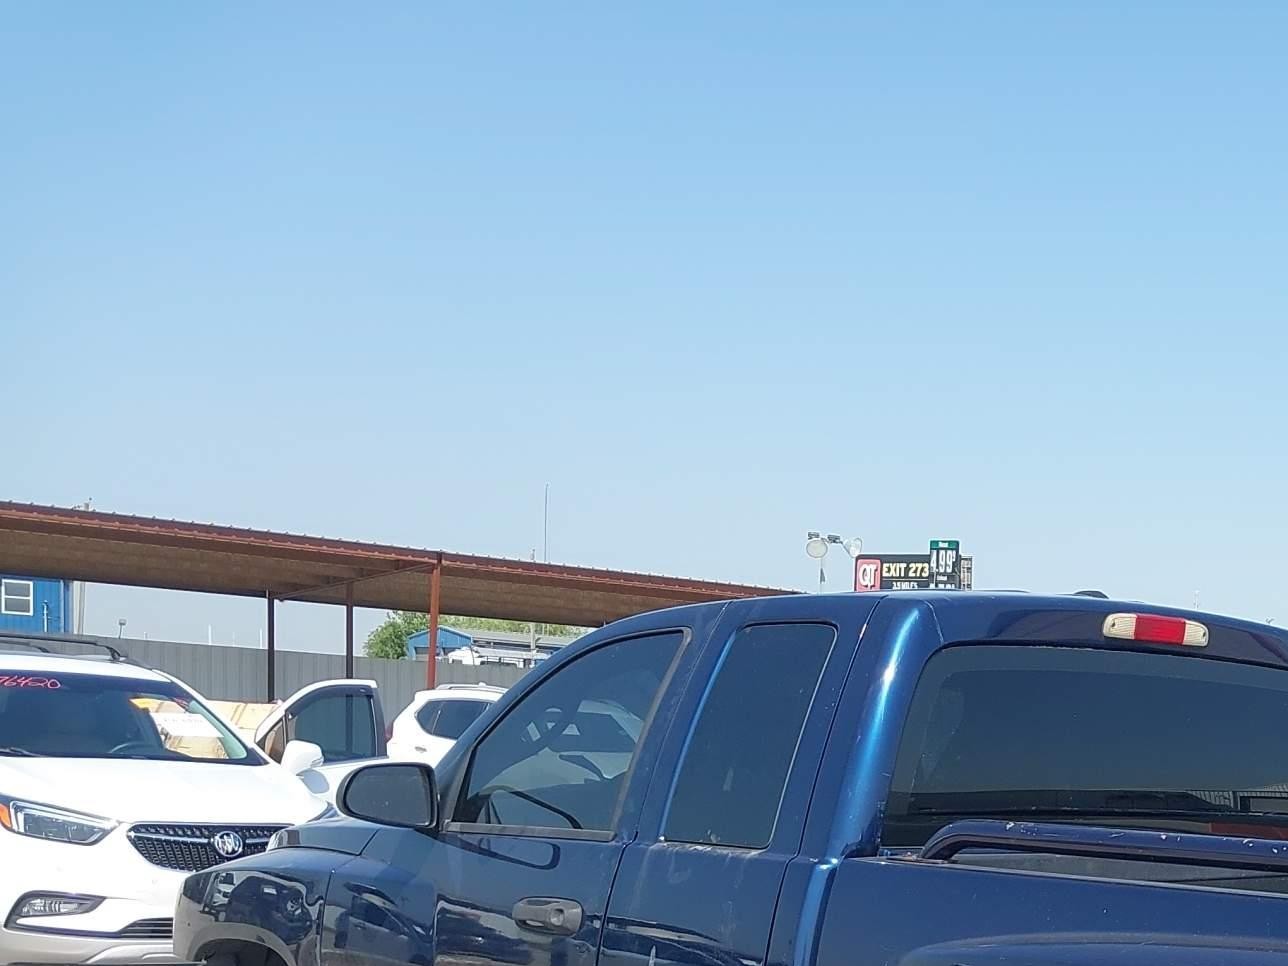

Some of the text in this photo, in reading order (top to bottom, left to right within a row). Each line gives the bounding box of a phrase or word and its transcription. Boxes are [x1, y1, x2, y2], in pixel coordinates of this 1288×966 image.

[882, 562, 930, 577] EXIT 273
[902, 581, 918, 590] MILES
